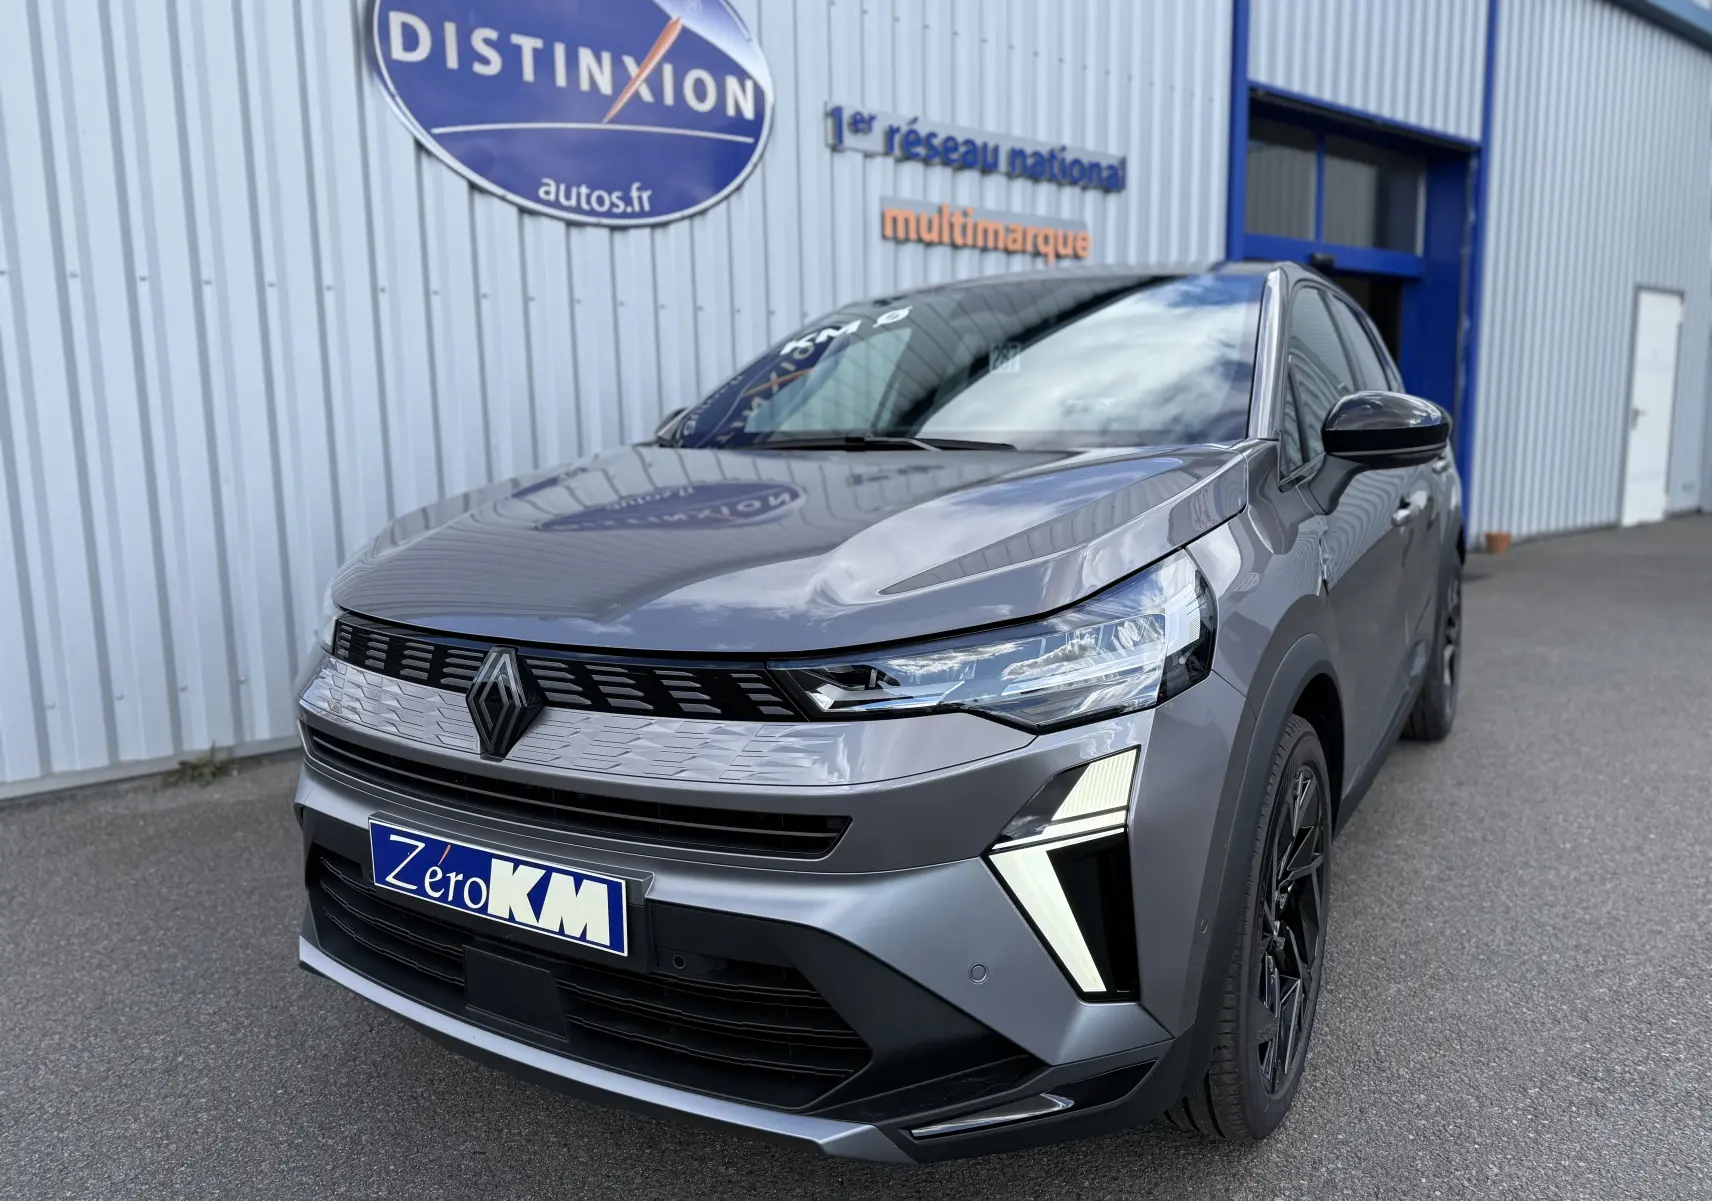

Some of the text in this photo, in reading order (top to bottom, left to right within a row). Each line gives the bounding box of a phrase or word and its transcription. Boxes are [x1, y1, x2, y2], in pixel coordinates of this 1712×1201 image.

[388, 10, 755, 121] DISTINXION
[830, 105, 1127, 192] 1er réseau national
[537, 177, 653, 214] autos.fr
[882, 203, 1091, 265] multimarque
